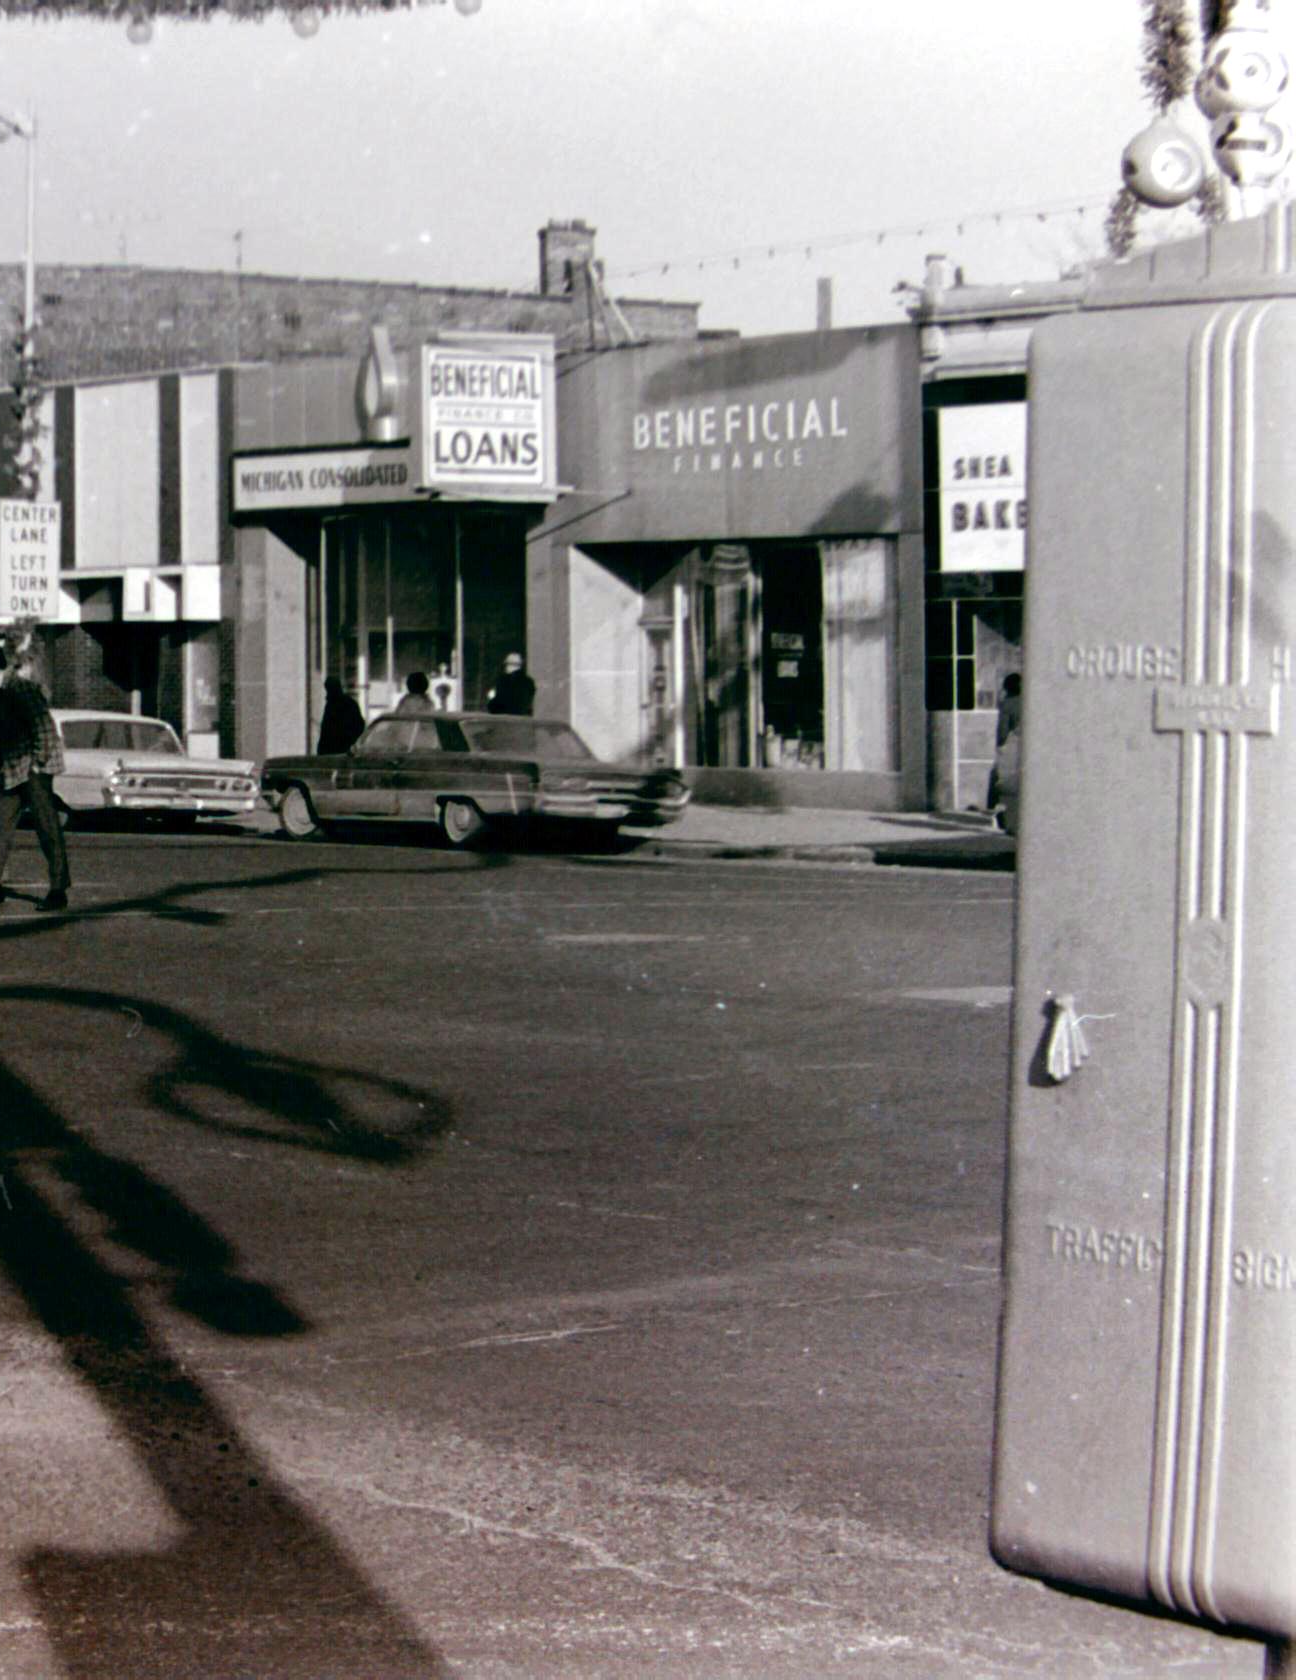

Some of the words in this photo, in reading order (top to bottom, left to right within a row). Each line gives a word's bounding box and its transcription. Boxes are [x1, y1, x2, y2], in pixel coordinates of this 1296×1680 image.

[430, 362, 541, 400] BENEFICIAL
[633, 397, 849, 451] BENEFICIAL
[433, 430, 539, 466] LOANS
[673, 448, 804, 474] FINANCE
[240, 470, 304, 492] MICHIGAN
[308, 463, 409, 490] CONSOLIDATED
[3, 505, 57, 524] CENTER
[10, 526, 49, 544] LANE
[10, 553, 47, 572] LEFT
[10, 574, 49, 592] TURN
[10, 594, 47, 612] ONLY
